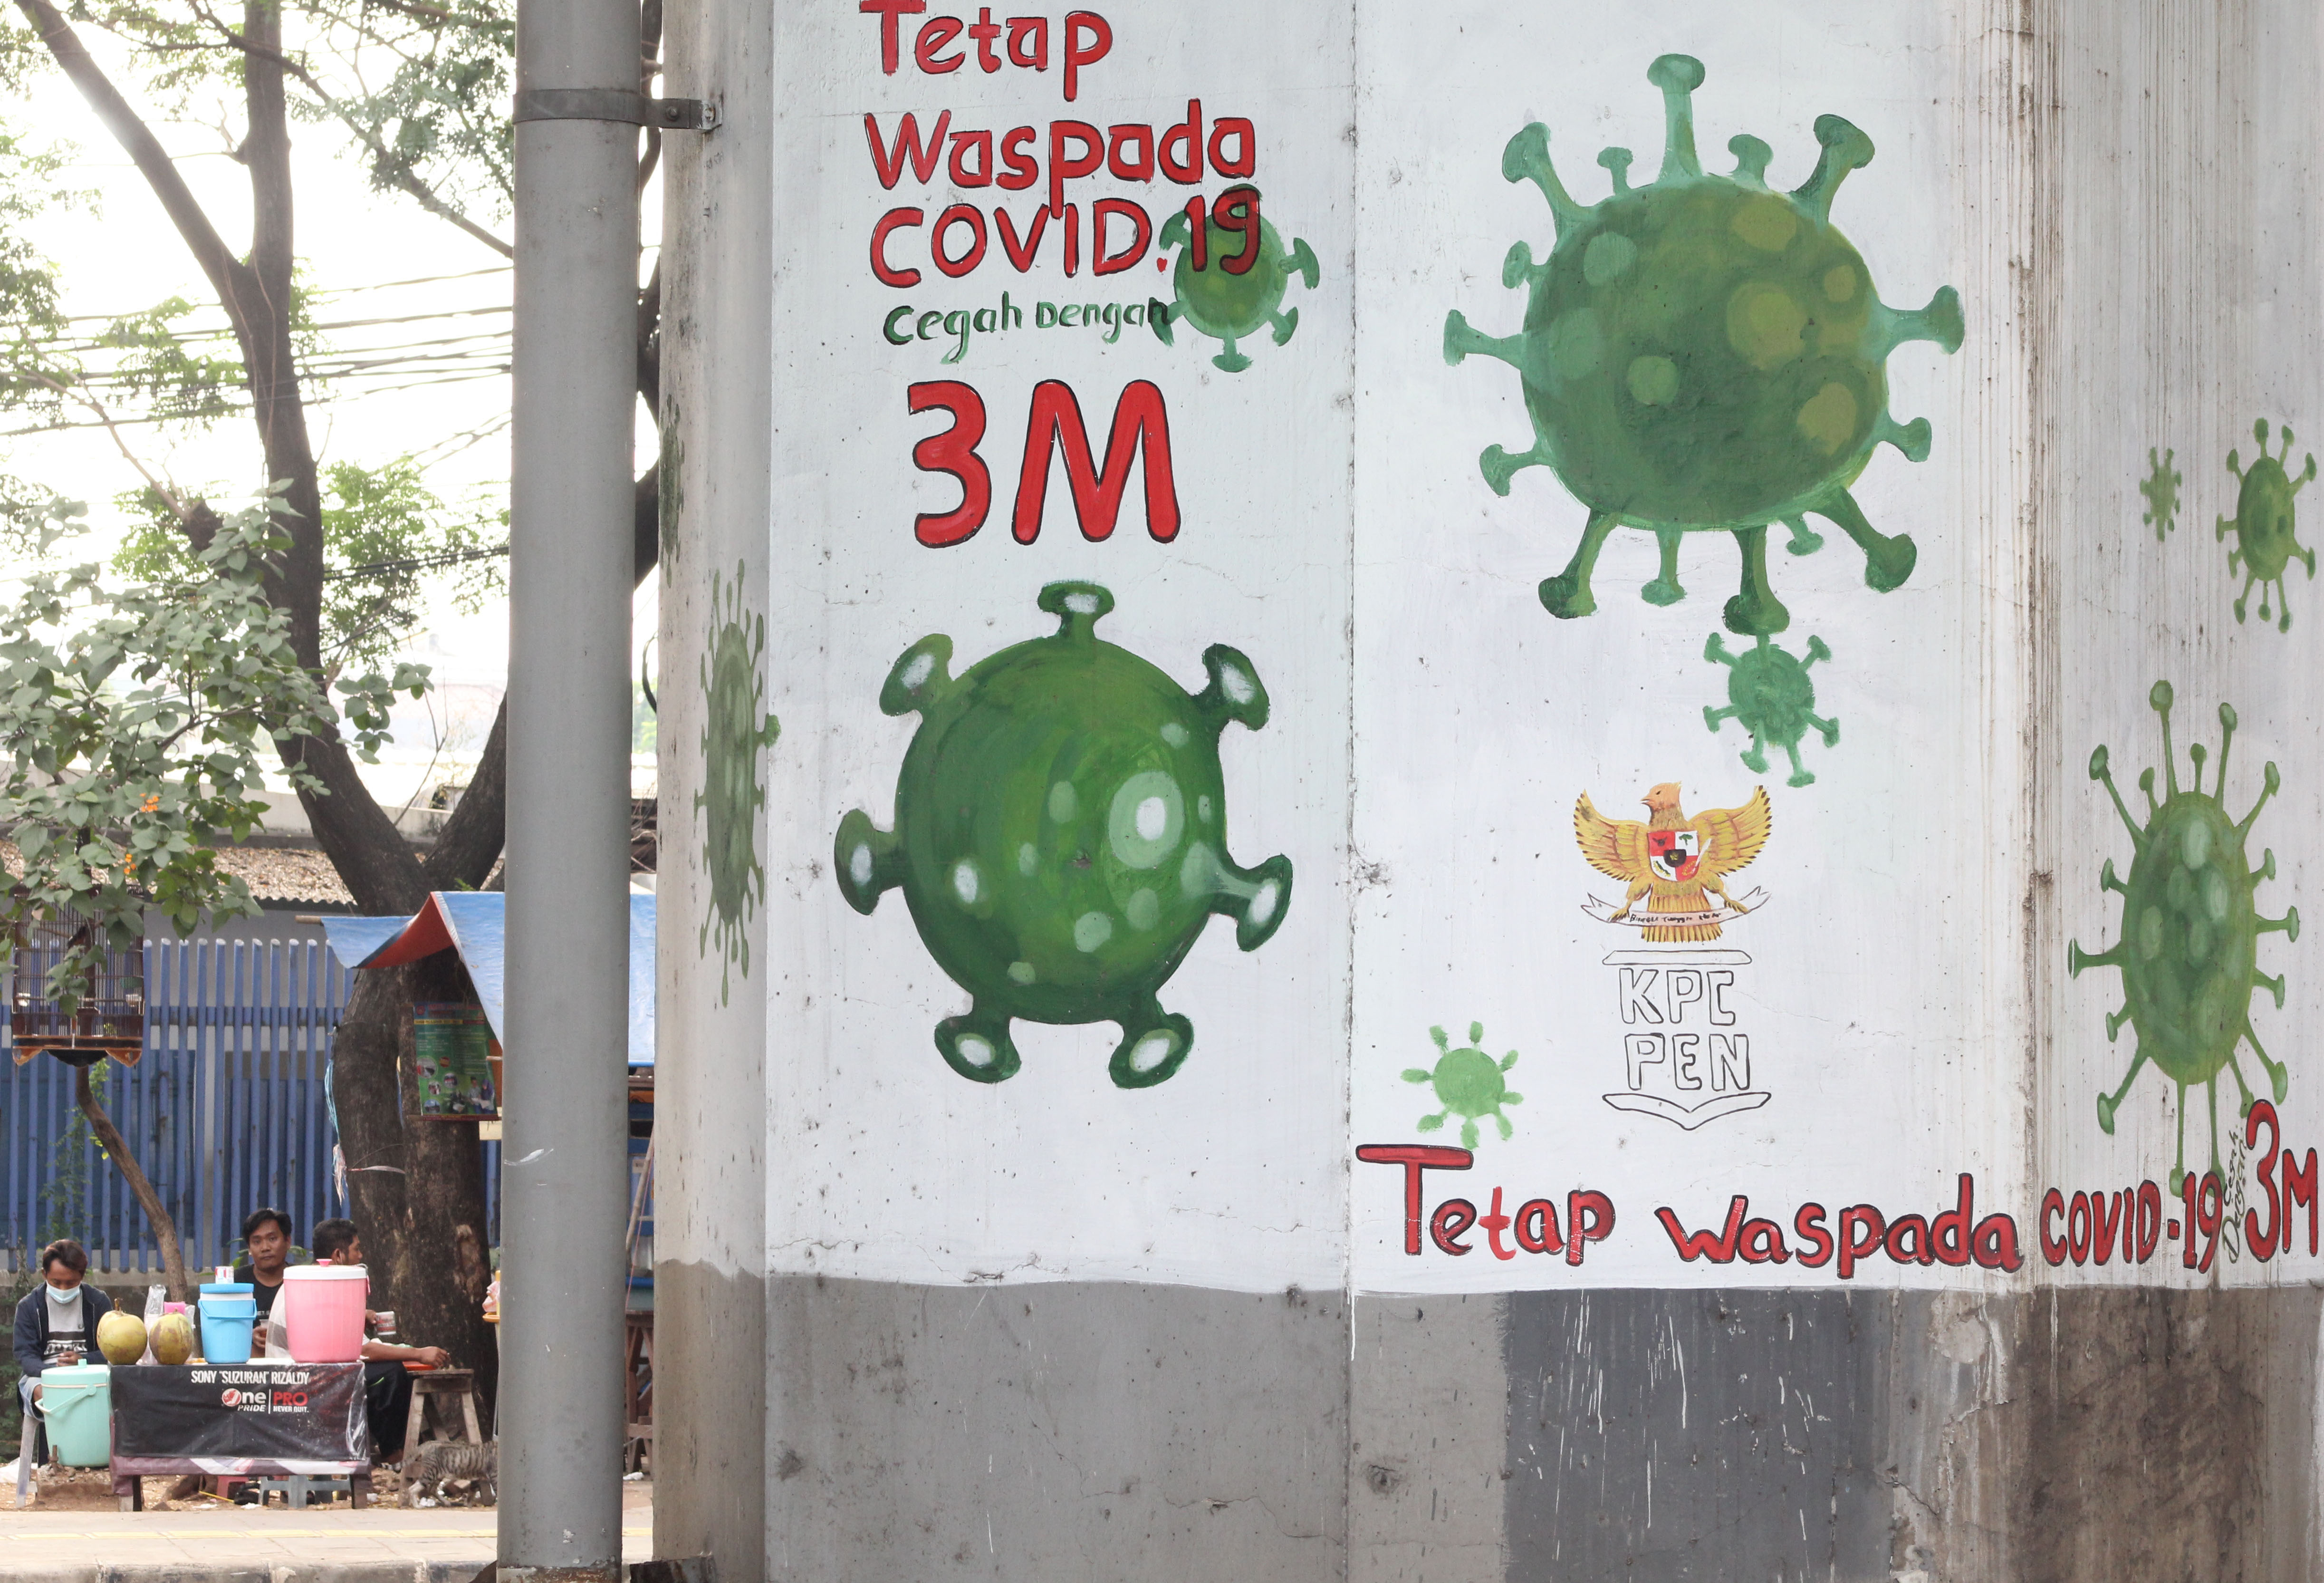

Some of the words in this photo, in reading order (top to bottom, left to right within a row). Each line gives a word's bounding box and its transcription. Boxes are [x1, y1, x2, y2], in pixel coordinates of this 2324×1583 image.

[859, 0, 1113, 101] Tetap
[864, 98, 1256, 220] Waspada
[883, 290, 1022, 365] Cegah
[1036, 297, 1168, 345] Dengan
[907, 379, 1181, 548] 3M
[1618, 967, 1736, 1026] KPC
[1624, 1033, 1751, 1091] PEN
[1355, 1143, 1616, 1266] Tetap
[1655, 1172, 2025, 1279] Waspada
[2039, 1171, 2223, 1274] COVID-19
[2245, 1099, 2318, 1263] 3M
[191, 1370, 217, 1384] SONY
[271, 1371, 310, 1385] RIZALDY
[273, 1391, 308, 1406] PRO
